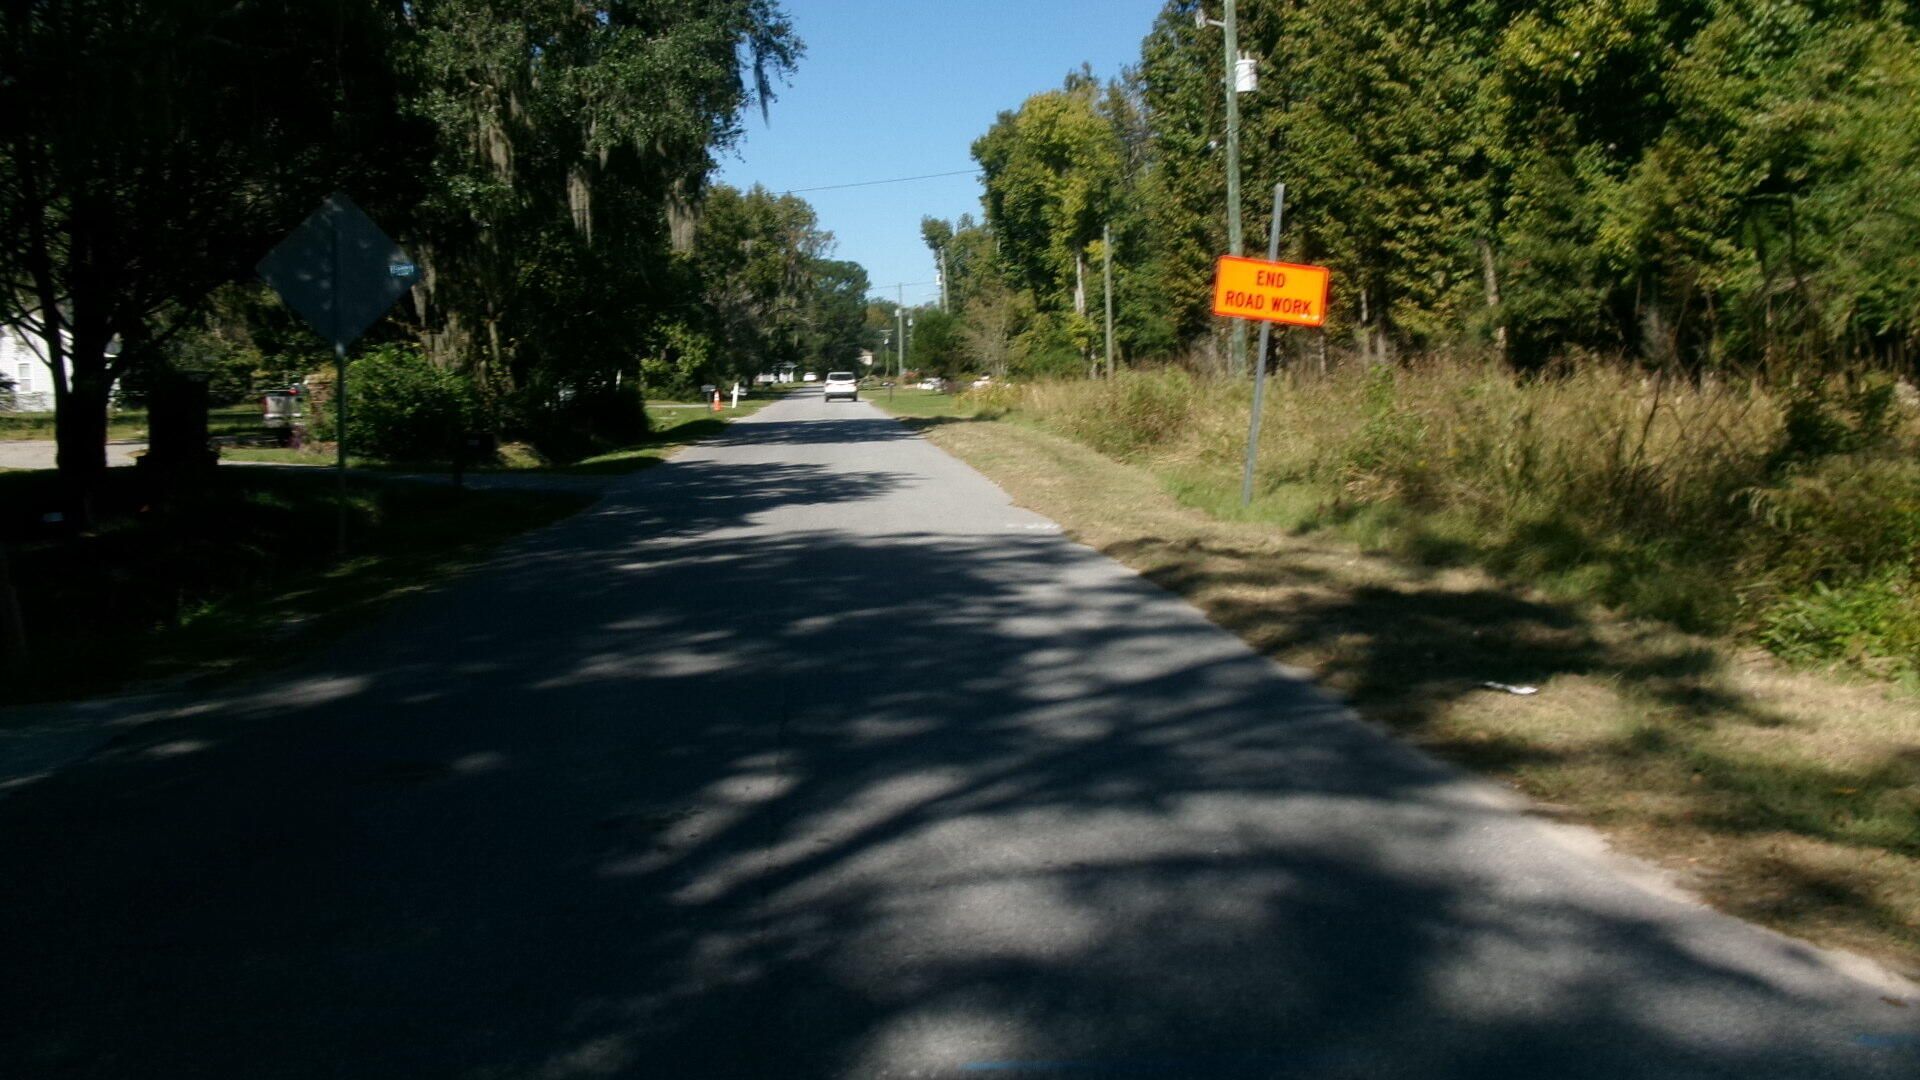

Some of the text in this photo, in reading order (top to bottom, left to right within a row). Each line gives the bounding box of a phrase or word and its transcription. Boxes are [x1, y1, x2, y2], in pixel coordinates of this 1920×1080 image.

[1257, 270, 1285, 288] END
[1225, 291, 1311, 315] ROAD WORK
